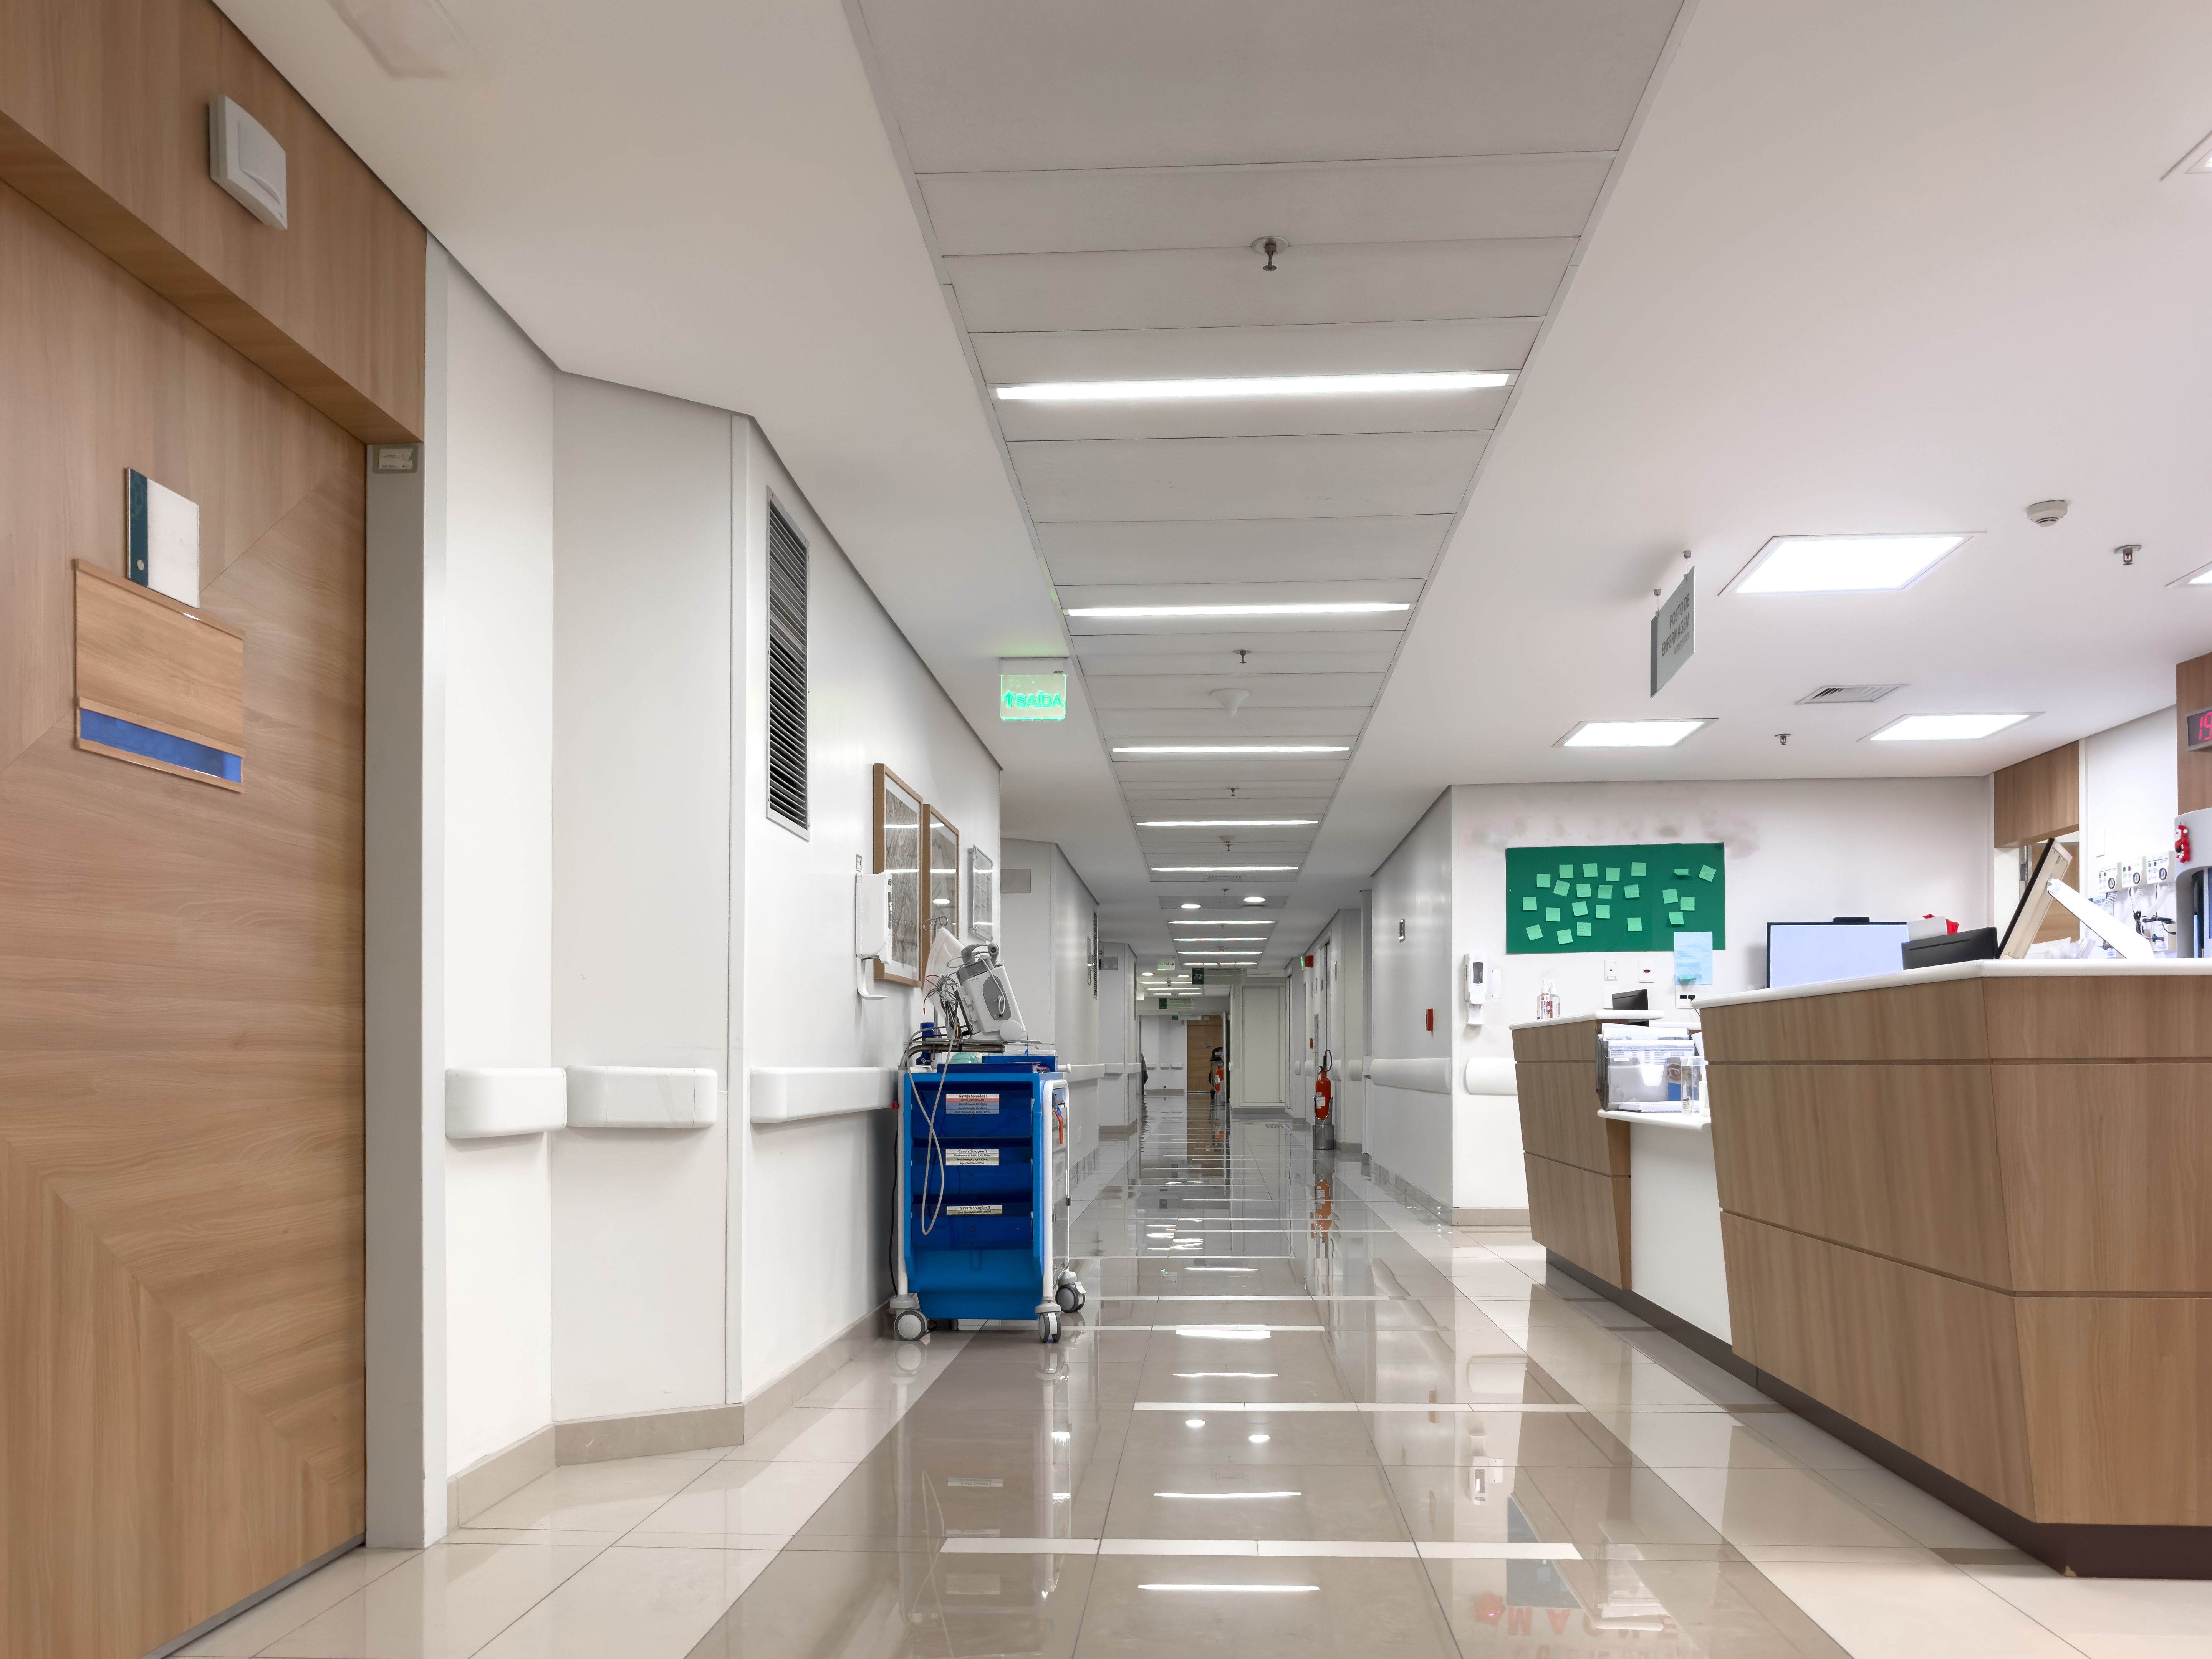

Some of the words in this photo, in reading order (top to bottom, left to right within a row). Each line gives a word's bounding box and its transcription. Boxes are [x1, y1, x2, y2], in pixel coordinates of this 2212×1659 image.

[1670, 601, 1683, 629] POSTO
[1684, 592, 1690, 611] DE
[1662, 612, 1690, 657] ENFERMAGEM
[1016, 690, 1063, 708] SAÍDA
